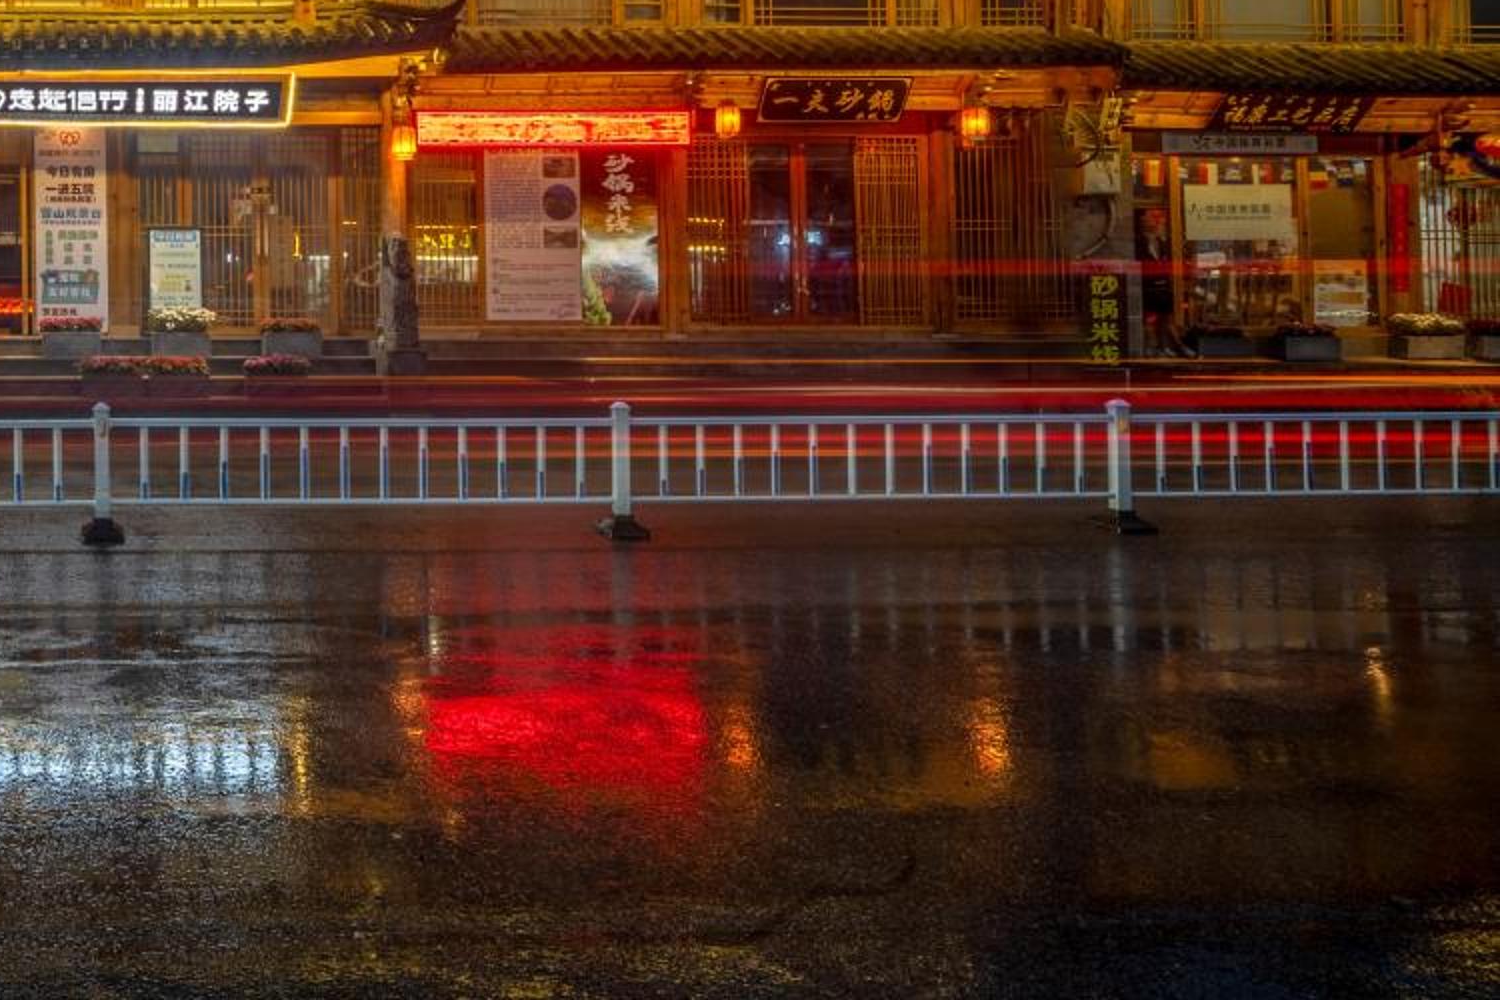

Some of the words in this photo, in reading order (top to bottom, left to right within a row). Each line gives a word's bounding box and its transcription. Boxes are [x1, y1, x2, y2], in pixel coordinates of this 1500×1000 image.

[152, 88, 270, 113] 丽江院子
[601, 153, 635, 233] 砂锅米线
[1091, 275, 1120, 366] 砂锅米线
